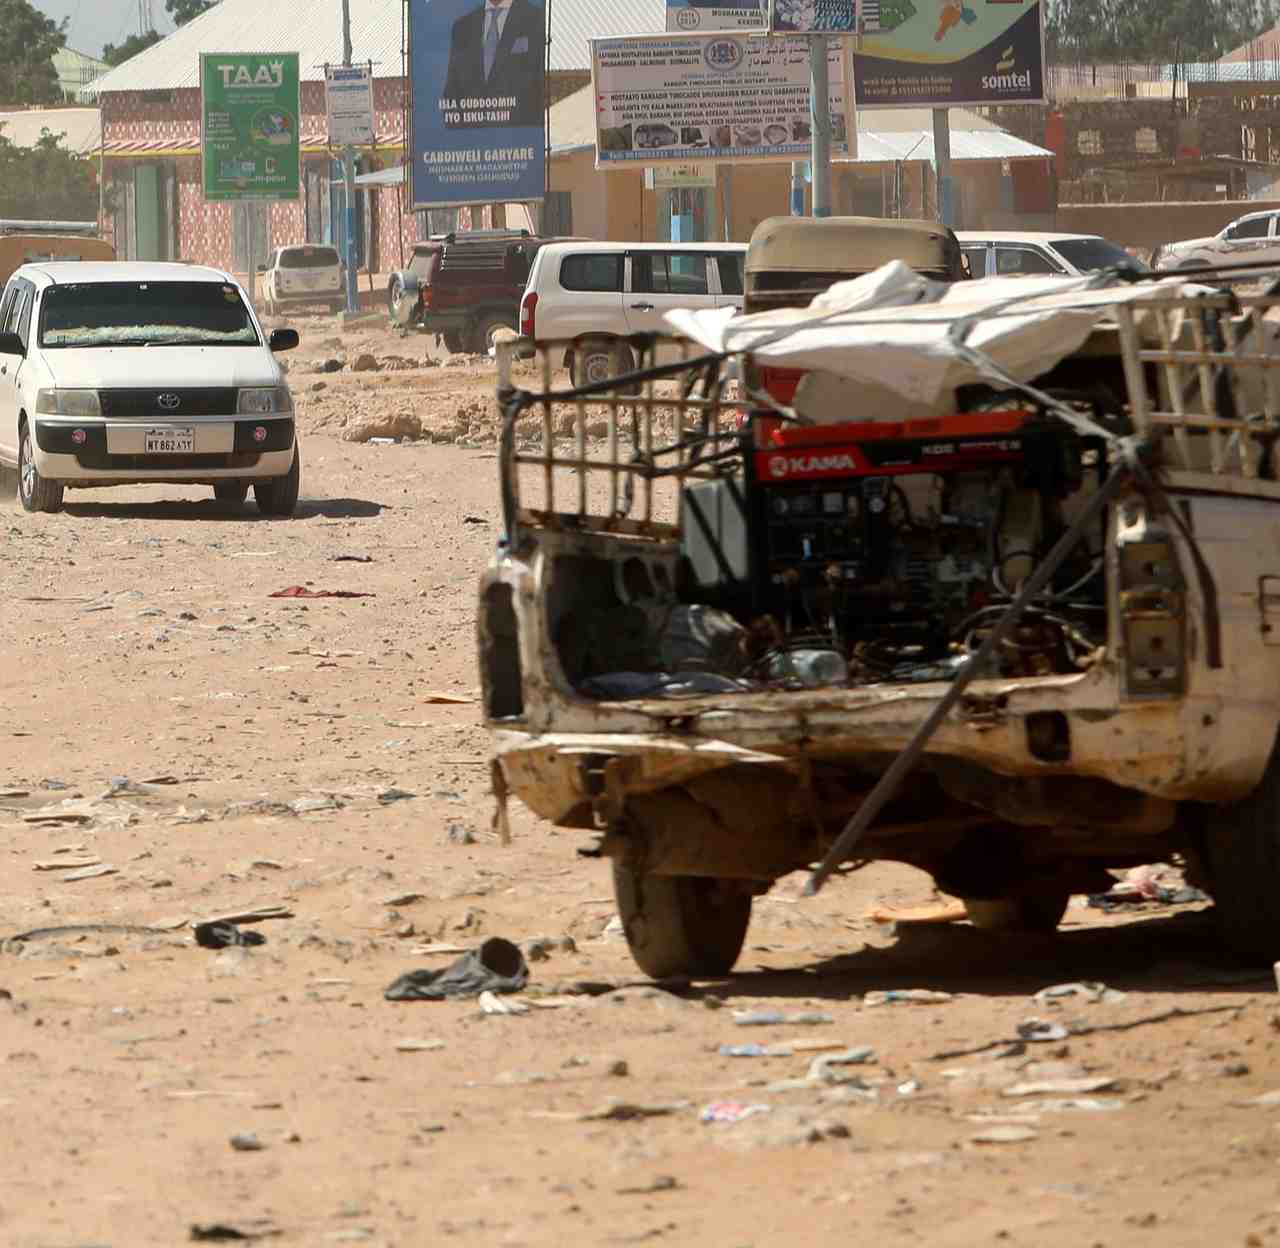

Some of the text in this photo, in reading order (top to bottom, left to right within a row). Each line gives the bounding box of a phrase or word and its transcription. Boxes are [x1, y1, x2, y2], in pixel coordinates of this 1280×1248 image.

[217, 61, 284, 87] TAAJ
[981, 69, 1032, 90] somtel
[438, 96, 517, 110] ISLA GUDDOOMIN
[444, 111, 460, 123] IYO
[423, 147, 535, 164] CABDIWELI GARYARE
[790, 454, 856, 472] KAMA
